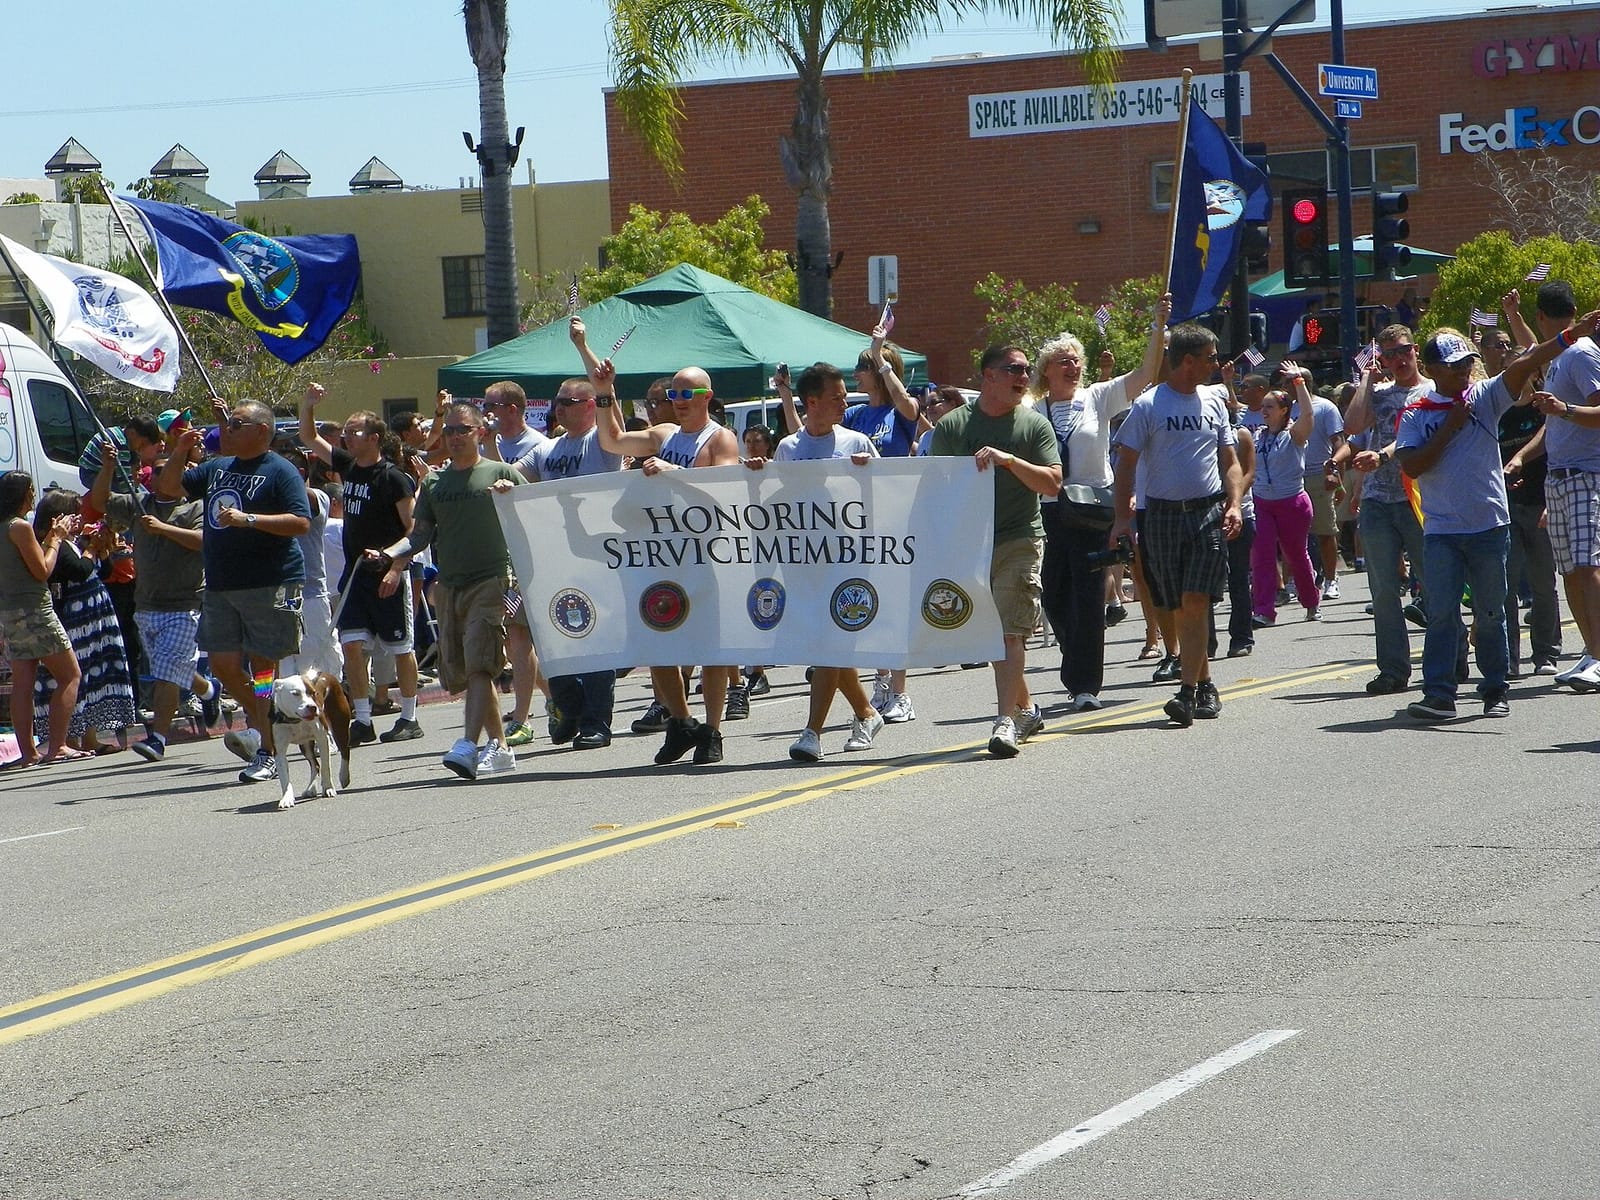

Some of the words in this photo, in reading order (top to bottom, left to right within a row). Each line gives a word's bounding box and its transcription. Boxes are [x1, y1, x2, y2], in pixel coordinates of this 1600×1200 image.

[1472, 33, 1600, 80] GYM
[975, 99, 1017, 130] SPACE
[1024, 92, 1094, 126] AVAILABLE
[1102, 82, 1208, 119] 858-546-404
[1439, 106, 1569, 155] FedEx
[1166, 415, 1214, 431] NAVY
[208, 468, 266, 500] NAVY
[642, 500, 868, 534] HONORING
[603, 534, 916, 570] SERVICEMEMBERS
